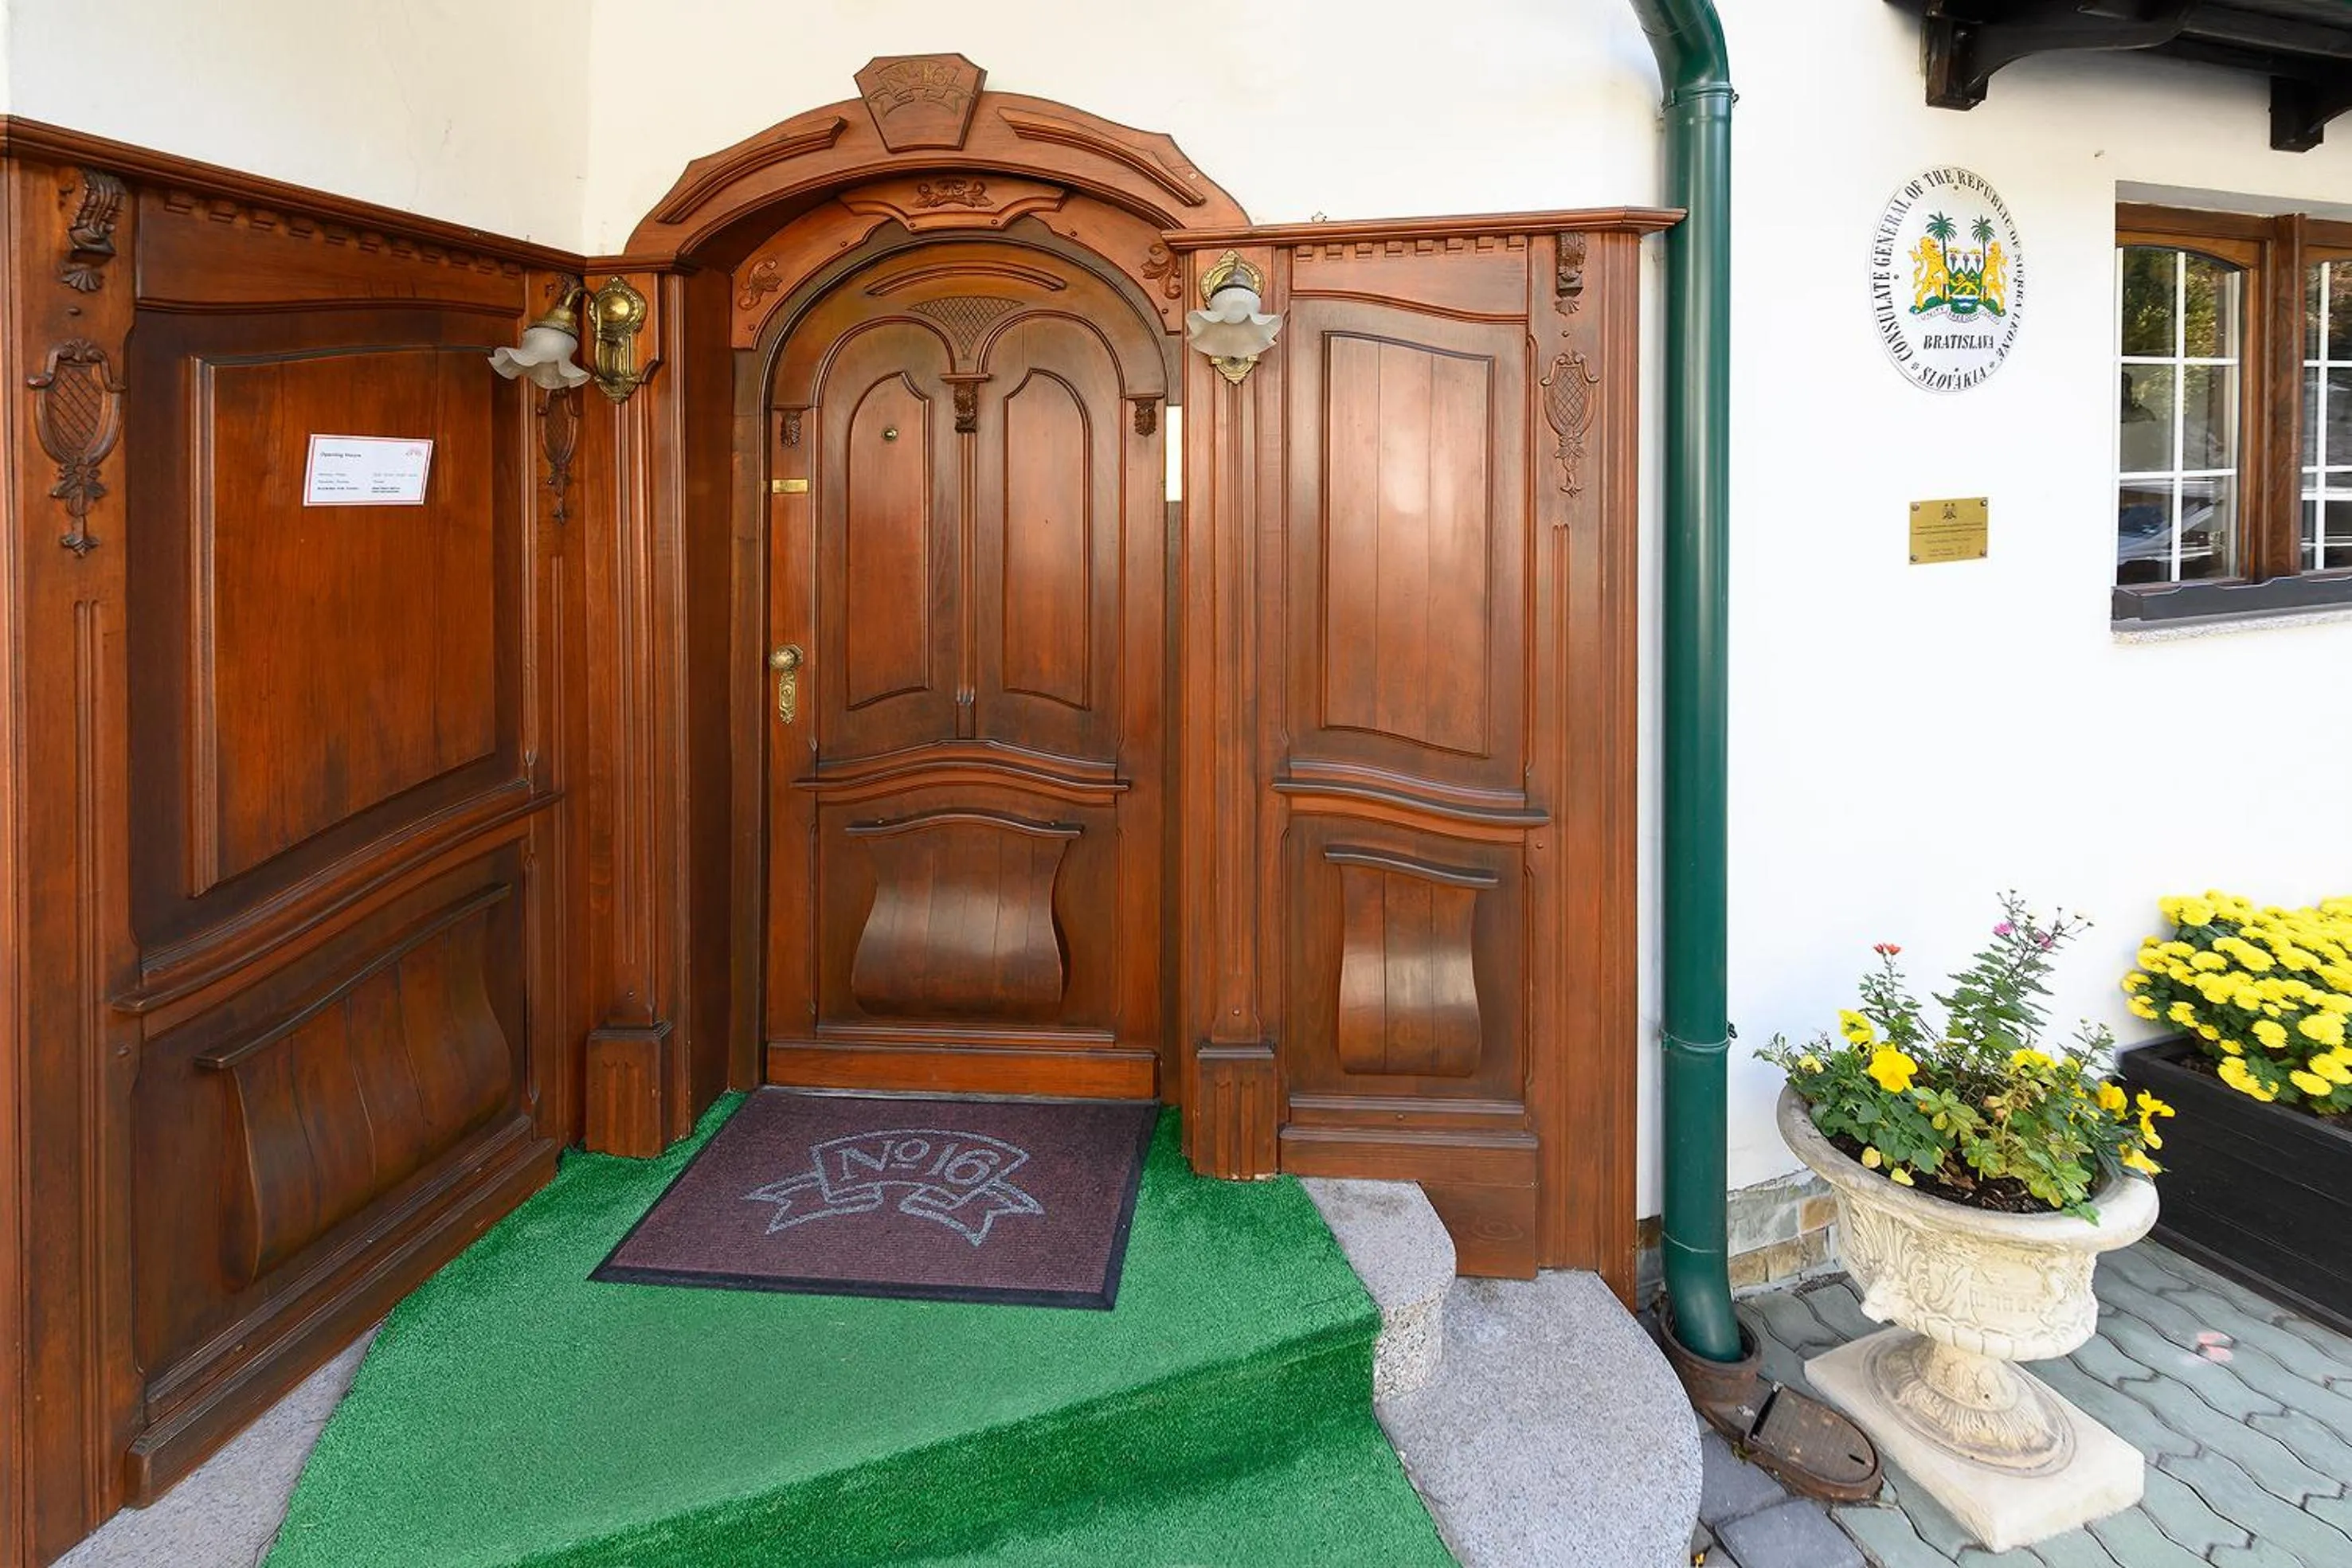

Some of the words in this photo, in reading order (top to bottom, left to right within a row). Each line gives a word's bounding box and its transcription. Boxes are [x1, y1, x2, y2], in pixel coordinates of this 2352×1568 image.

[1922, 168, 1955, 188] THE
[1904, 180, 1925, 201] OF
[1957, 170, 2013, 228] REPUBLIC
[1873, 200, 1912, 268] GENERAL
[2008, 229, 2021, 251] OF
[1873, 273, 1913, 363] CONSULATE
[1923, 334, 1994, 350] BRATISLAVA
[1995, 311, 2020, 362] LEONE
[1918, 366, 1986, 390] SLOVAKIA
